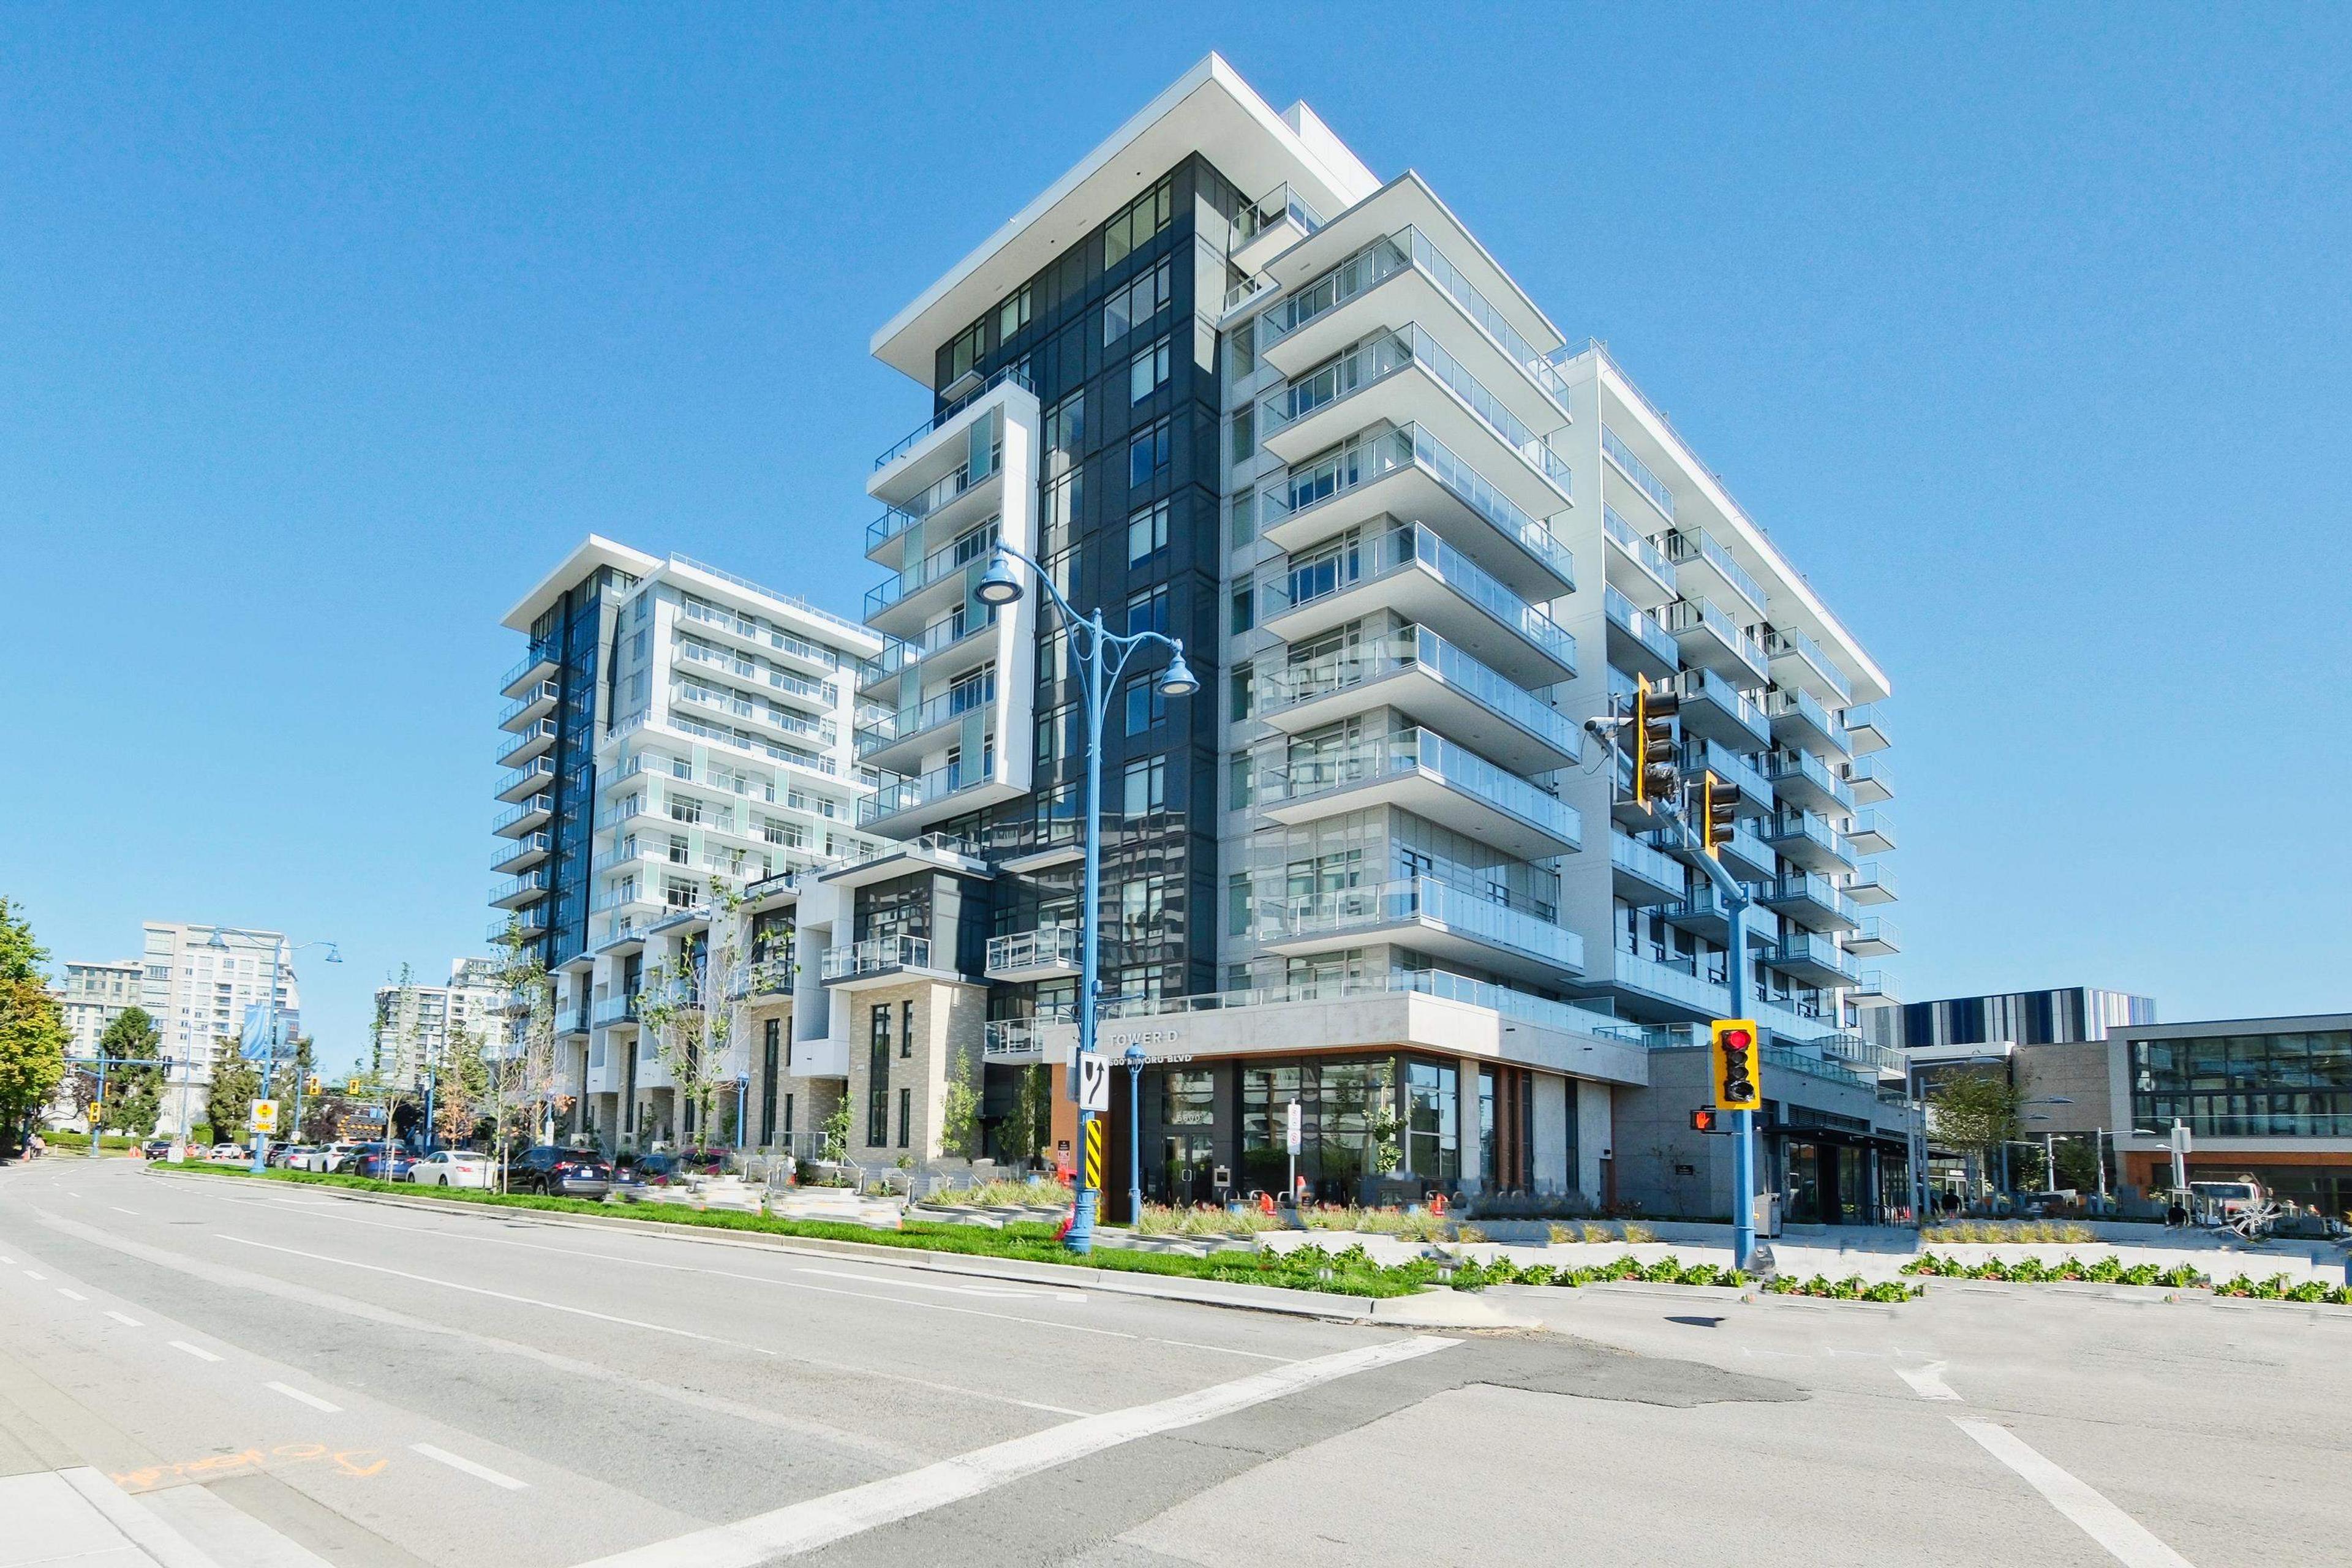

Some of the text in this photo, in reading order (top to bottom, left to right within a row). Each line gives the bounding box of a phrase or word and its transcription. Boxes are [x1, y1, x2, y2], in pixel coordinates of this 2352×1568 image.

[1109, 1030, 1178, 1046] TOWER D
[1167, 1054, 1192, 1063] BLVD
